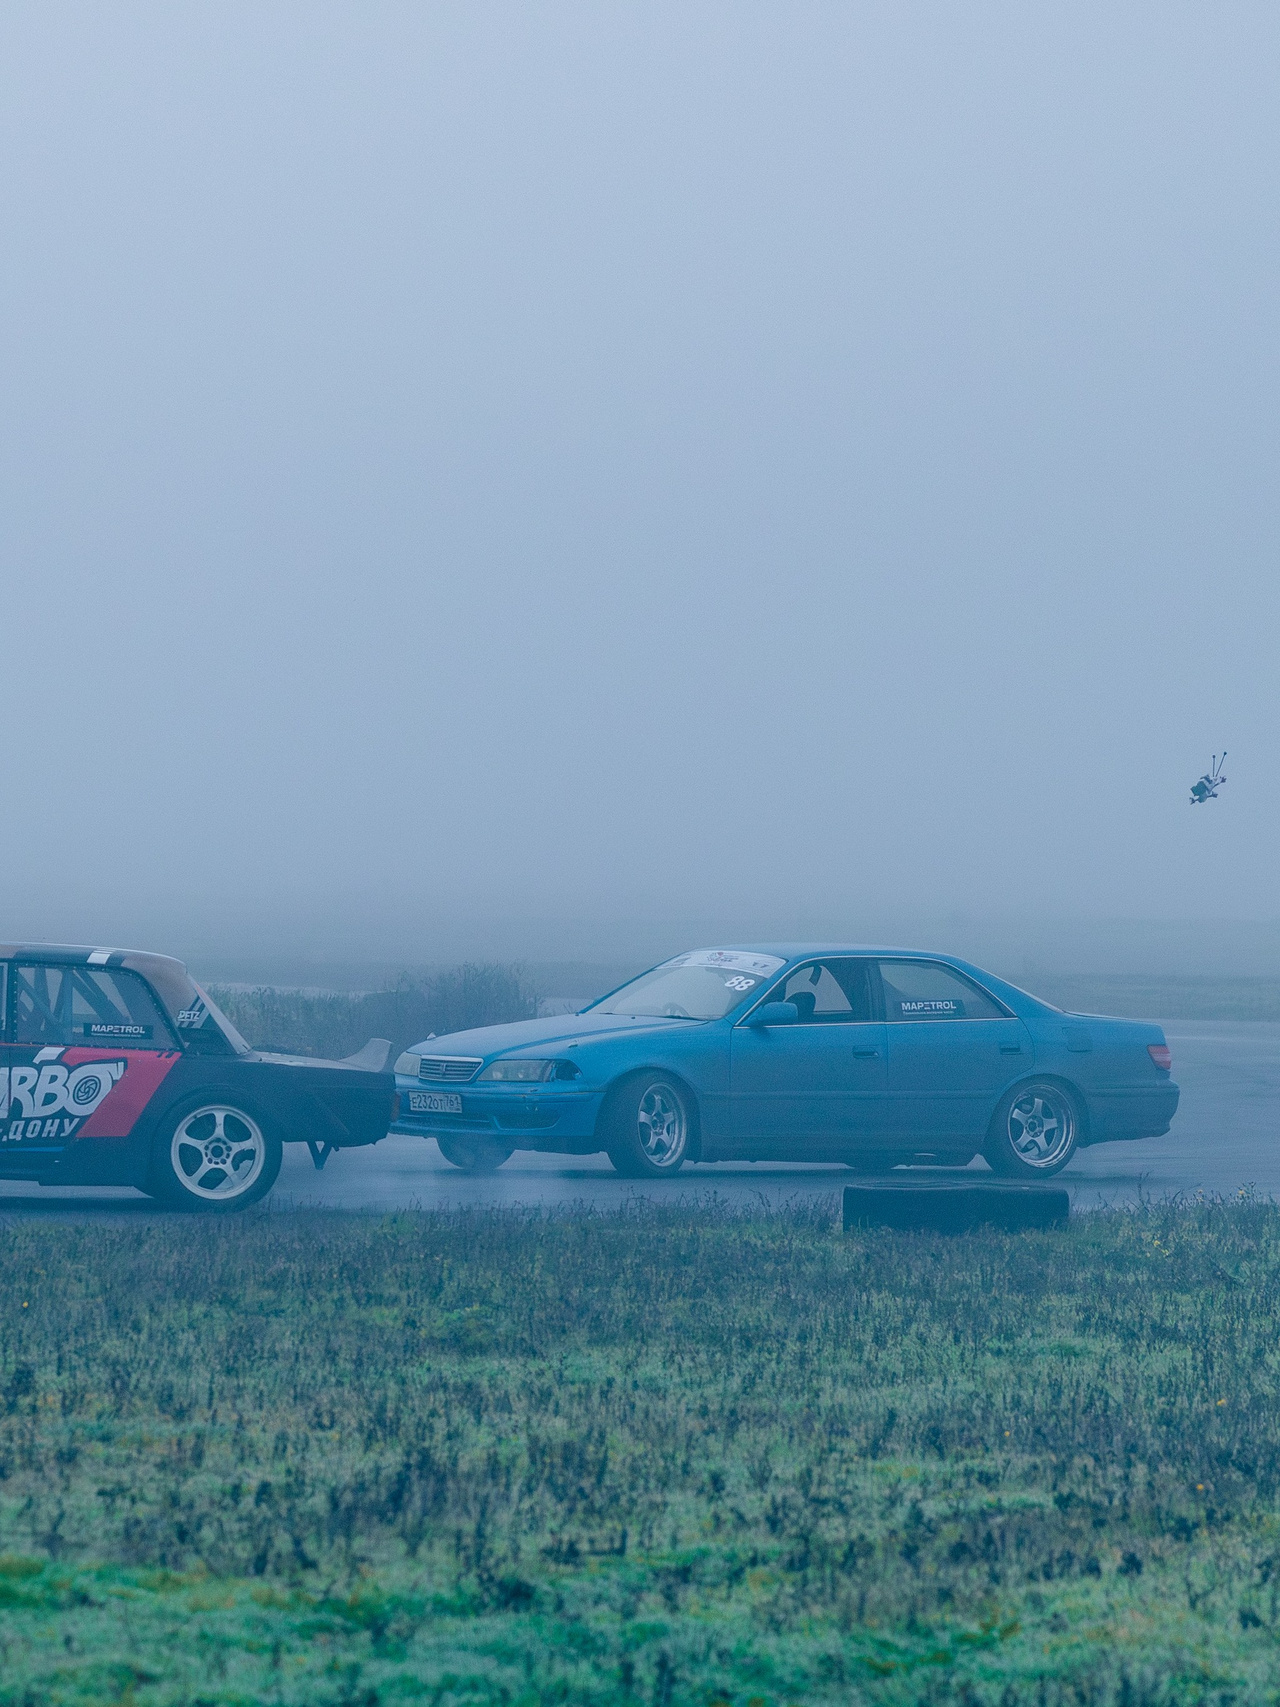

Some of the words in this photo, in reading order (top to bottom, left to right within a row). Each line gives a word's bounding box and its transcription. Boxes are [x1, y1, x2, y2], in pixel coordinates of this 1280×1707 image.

[724, 975, 756, 991] 88
[901, 1001, 956, 1011] MAPETROL
[91, 1024, 146, 1034] MAPETROL
